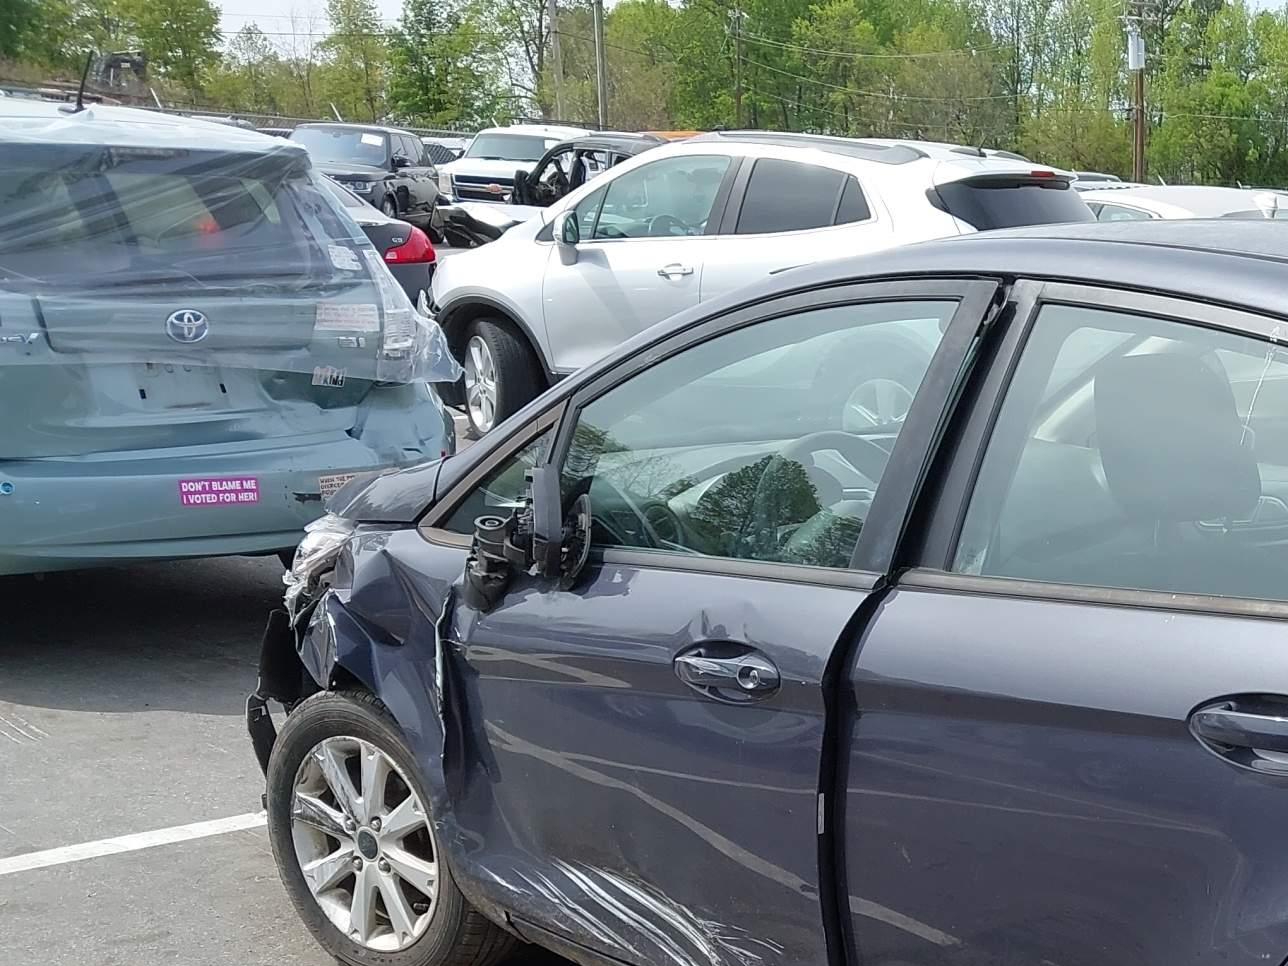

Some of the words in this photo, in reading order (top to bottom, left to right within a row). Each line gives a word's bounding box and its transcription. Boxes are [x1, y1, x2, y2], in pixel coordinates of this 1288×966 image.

[181, 481, 210, 492] DON'T
[212, 480, 241, 491] BLAME
[243, 480, 257, 489] ME
[183, 494, 187, 504] I
[188, 494, 217, 504] VOTED
[219, 493, 236, 502] FOR
[238, 492, 257, 502] HER!
